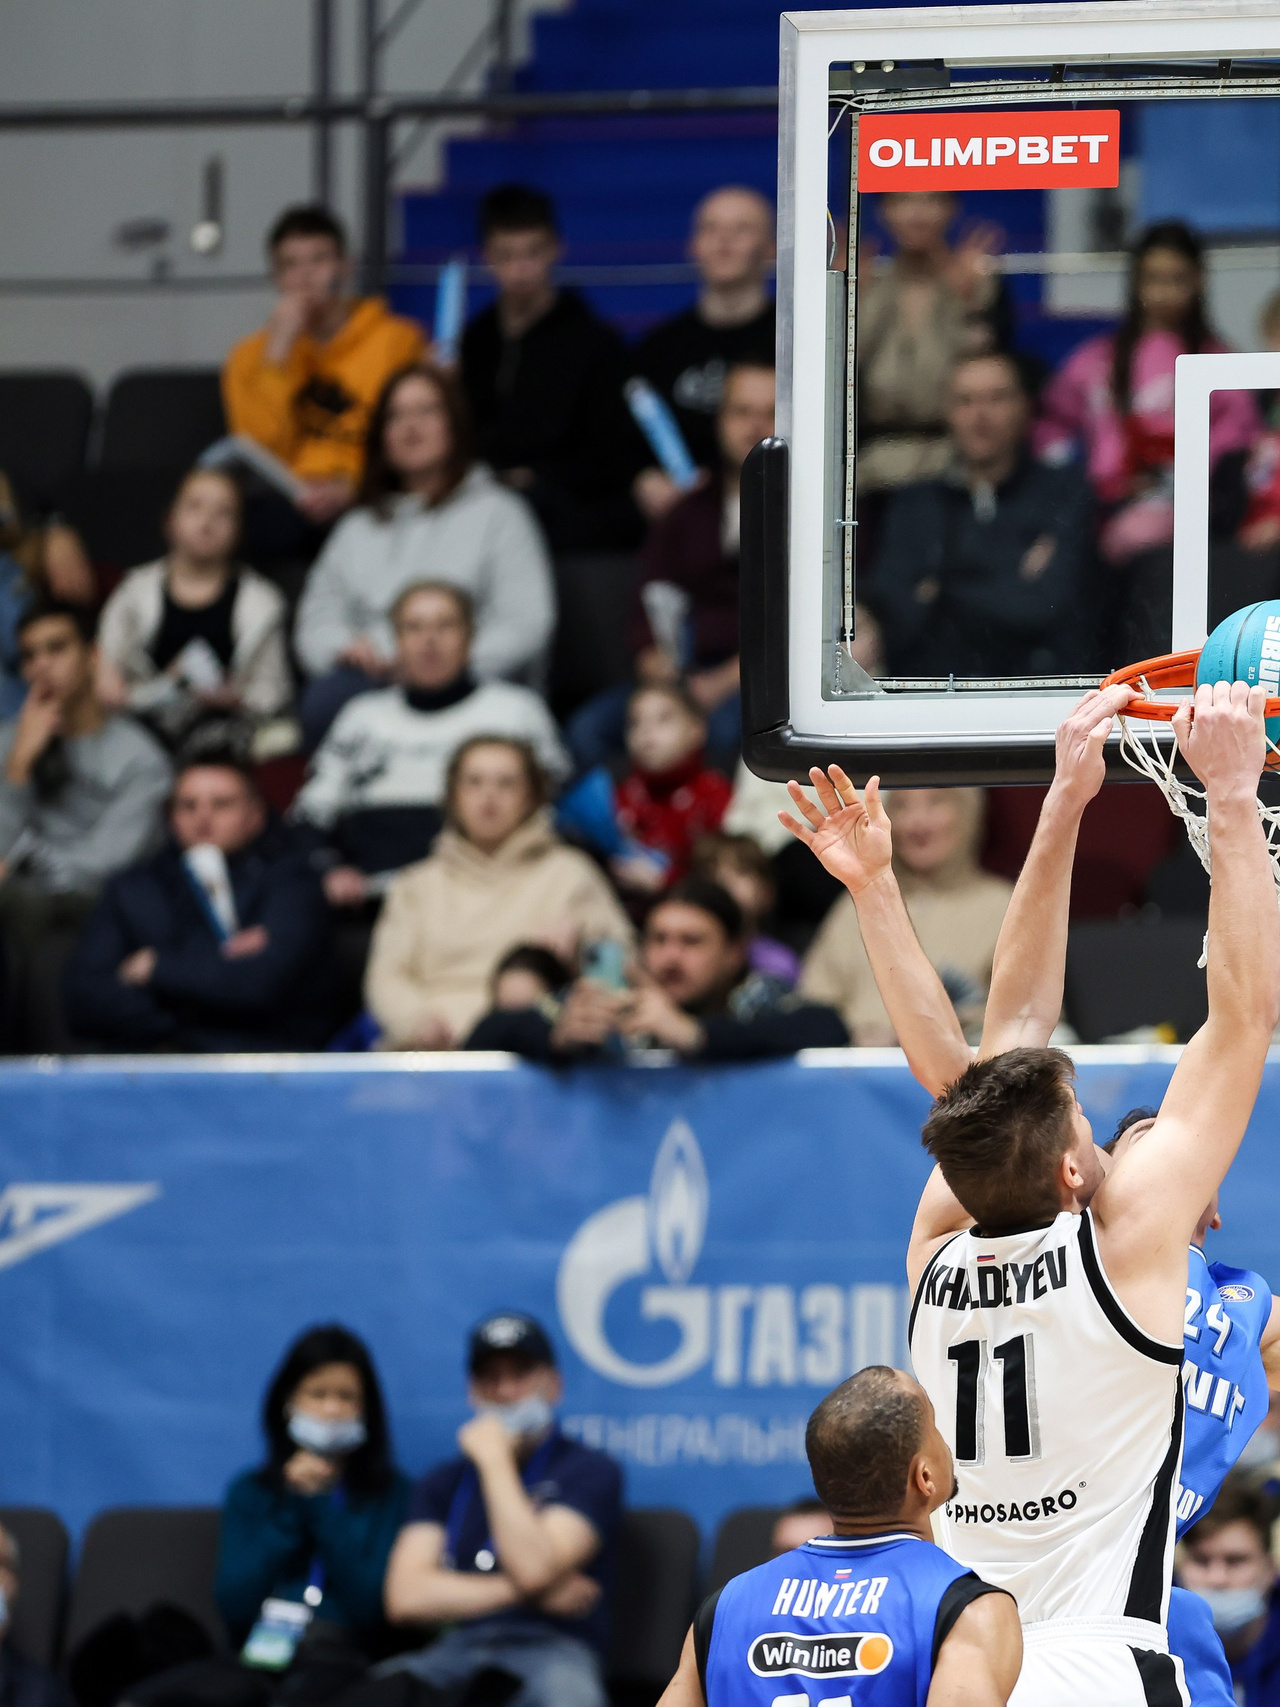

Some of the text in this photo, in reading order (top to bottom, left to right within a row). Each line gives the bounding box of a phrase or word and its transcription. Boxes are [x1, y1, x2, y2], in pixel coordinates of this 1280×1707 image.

[868, 134, 1109, 168] OLIMPBET
[712, 1282, 912, 1388] ГАЗП
[947, 1334, 1041, 1466] 11
[1180, 1357, 1247, 1434] NIT
[954, 1488, 1078, 1524] PHOSAGRO
[771, 1576, 889, 1620] HUNTER
[762, 1641, 851, 1669] Winline
